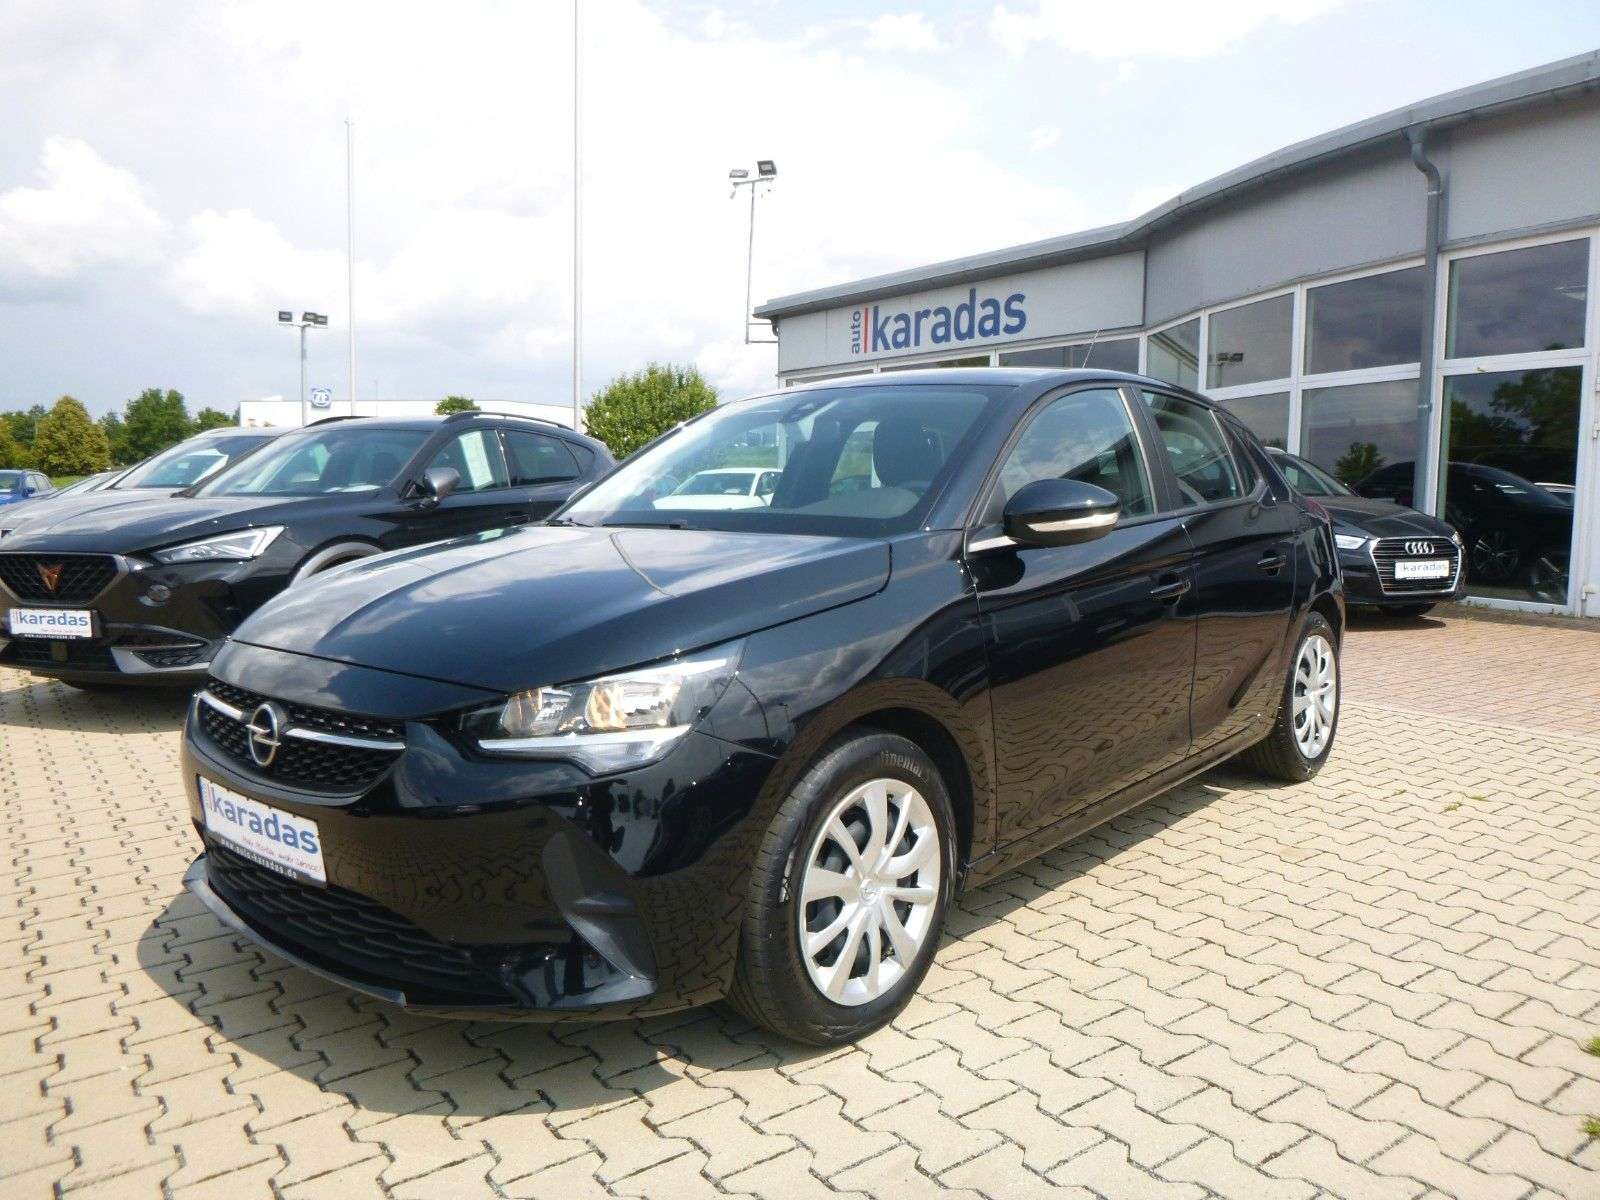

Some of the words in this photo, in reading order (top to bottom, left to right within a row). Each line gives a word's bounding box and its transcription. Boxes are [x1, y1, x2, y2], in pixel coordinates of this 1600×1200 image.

[850, 311, 861, 354] auto
[872, 288, 1027, 352] karadas
[1403, 564, 1447, 572] karadas
[19, 612, 89, 627] karadas
[211, 786, 319, 855] karadas
